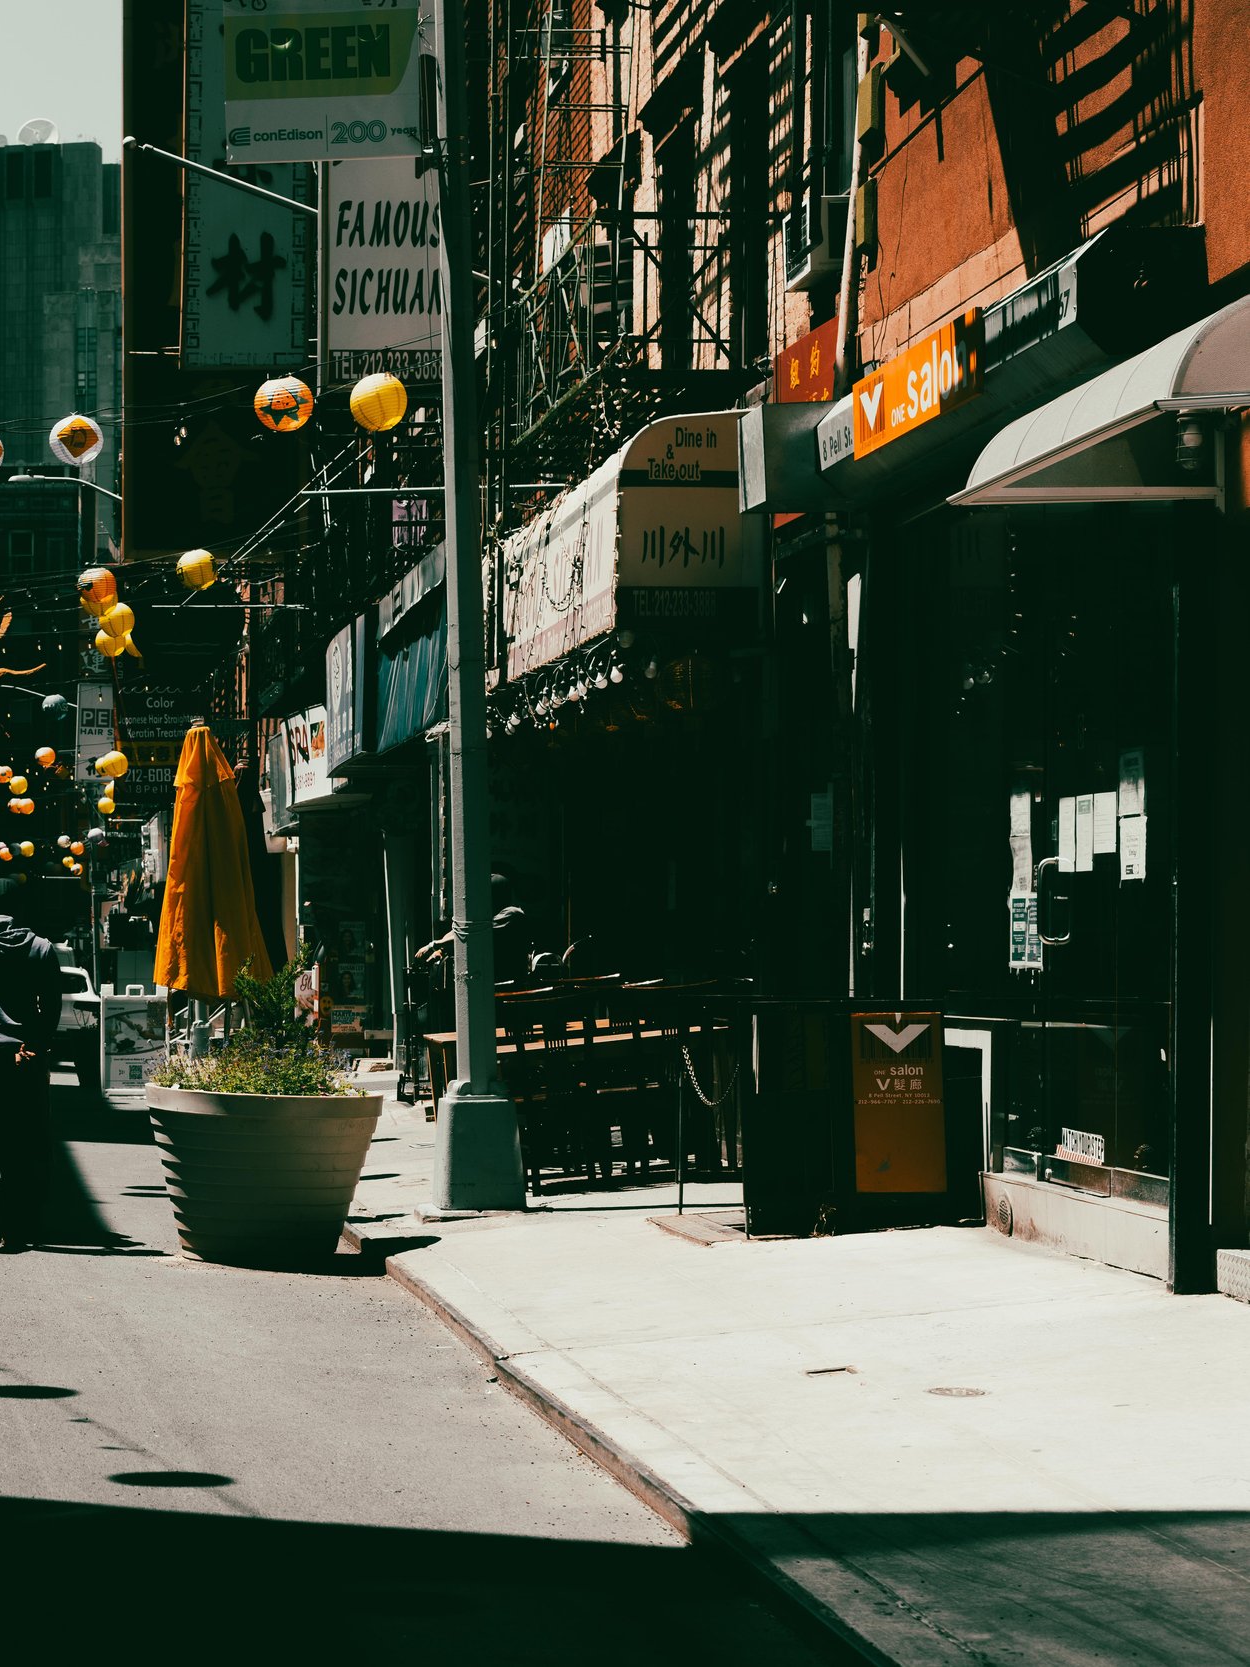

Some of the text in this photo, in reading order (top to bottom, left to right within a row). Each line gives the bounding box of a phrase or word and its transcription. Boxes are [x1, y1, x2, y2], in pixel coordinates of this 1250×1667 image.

[235, 24, 390, 83] GREEN
[253, 128, 323, 142] conEdison
[330, 119, 387, 144] 200
[335, 200, 440, 248] FAMOUS
[332, 268, 442, 316] SICHUAN
[891, 338, 967, 428] ONE salon
[675, 427, 717, 449] Dine in
[822, 425, 853, 461] 8 Pell St.
[666, 444, 675, 460] &
[648, 457, 700, 481] Take out
[641, 525, 725, 569] 川外川
[145, 697, 175, 709] Color
[82, 711, 112, 727] PE
[118, 715, 147, 726] Japanese
[148, 714, 164, 724] Hair
[80, 727, 104, 736] HAIR
[127, 727, 187, 738] Keratin Treatm
[125, 767, 176, 783] 212-608-
[144, 785, 168, 795] Pell
[890, 1064, 924, 1076] salon
[876, 1078, 891, 1091] V
